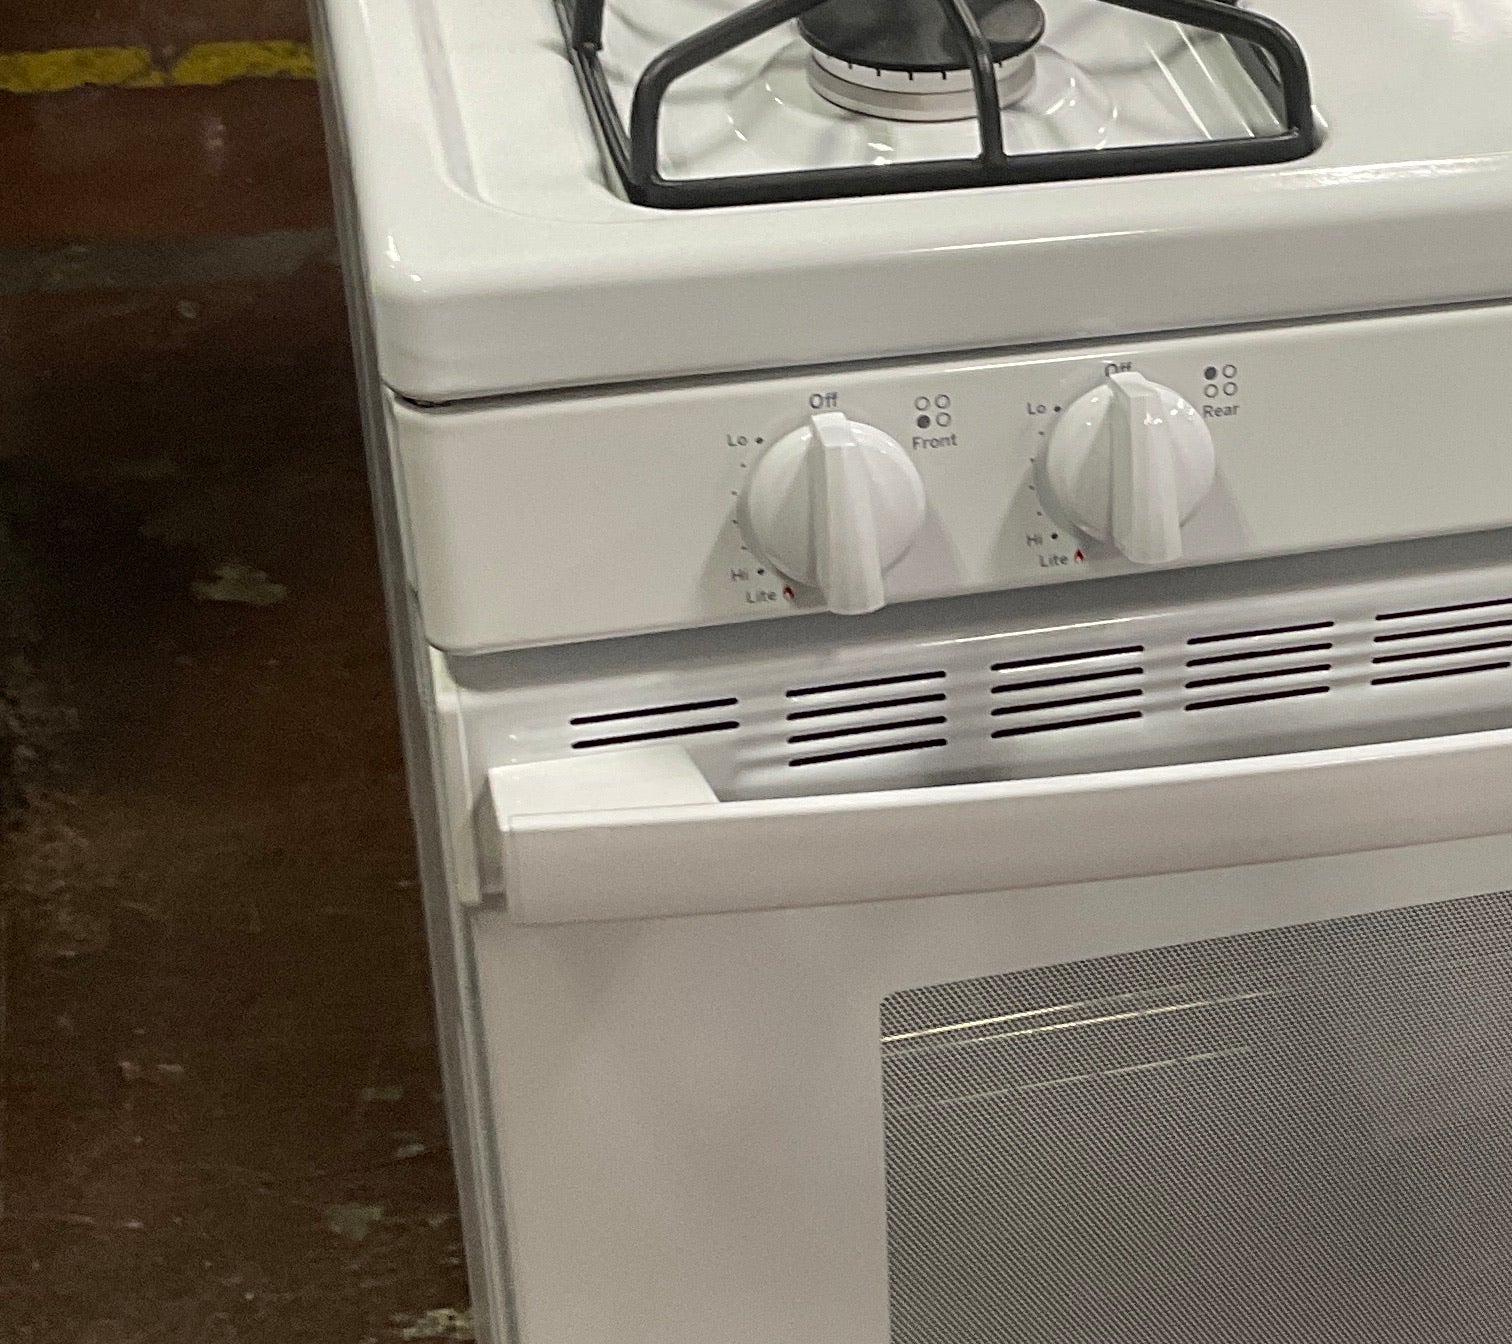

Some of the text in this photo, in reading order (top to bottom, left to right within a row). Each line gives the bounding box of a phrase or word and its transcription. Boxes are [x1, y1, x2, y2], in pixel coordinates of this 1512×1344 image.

[809, 392, 837, 409] Off
[1028, 403, 1046, 415] Lo
[1203, 404, 1240, 418] Rear
[727, 433, 748, 447] Lo
[912, 433, 958, 450] Front
[1026, 534, 1043, 547] Hi
[1039, 555, 1068, 568] Lite
[731, 568, 749, 582] Hi
[745, 589, 777, 604] Lite
